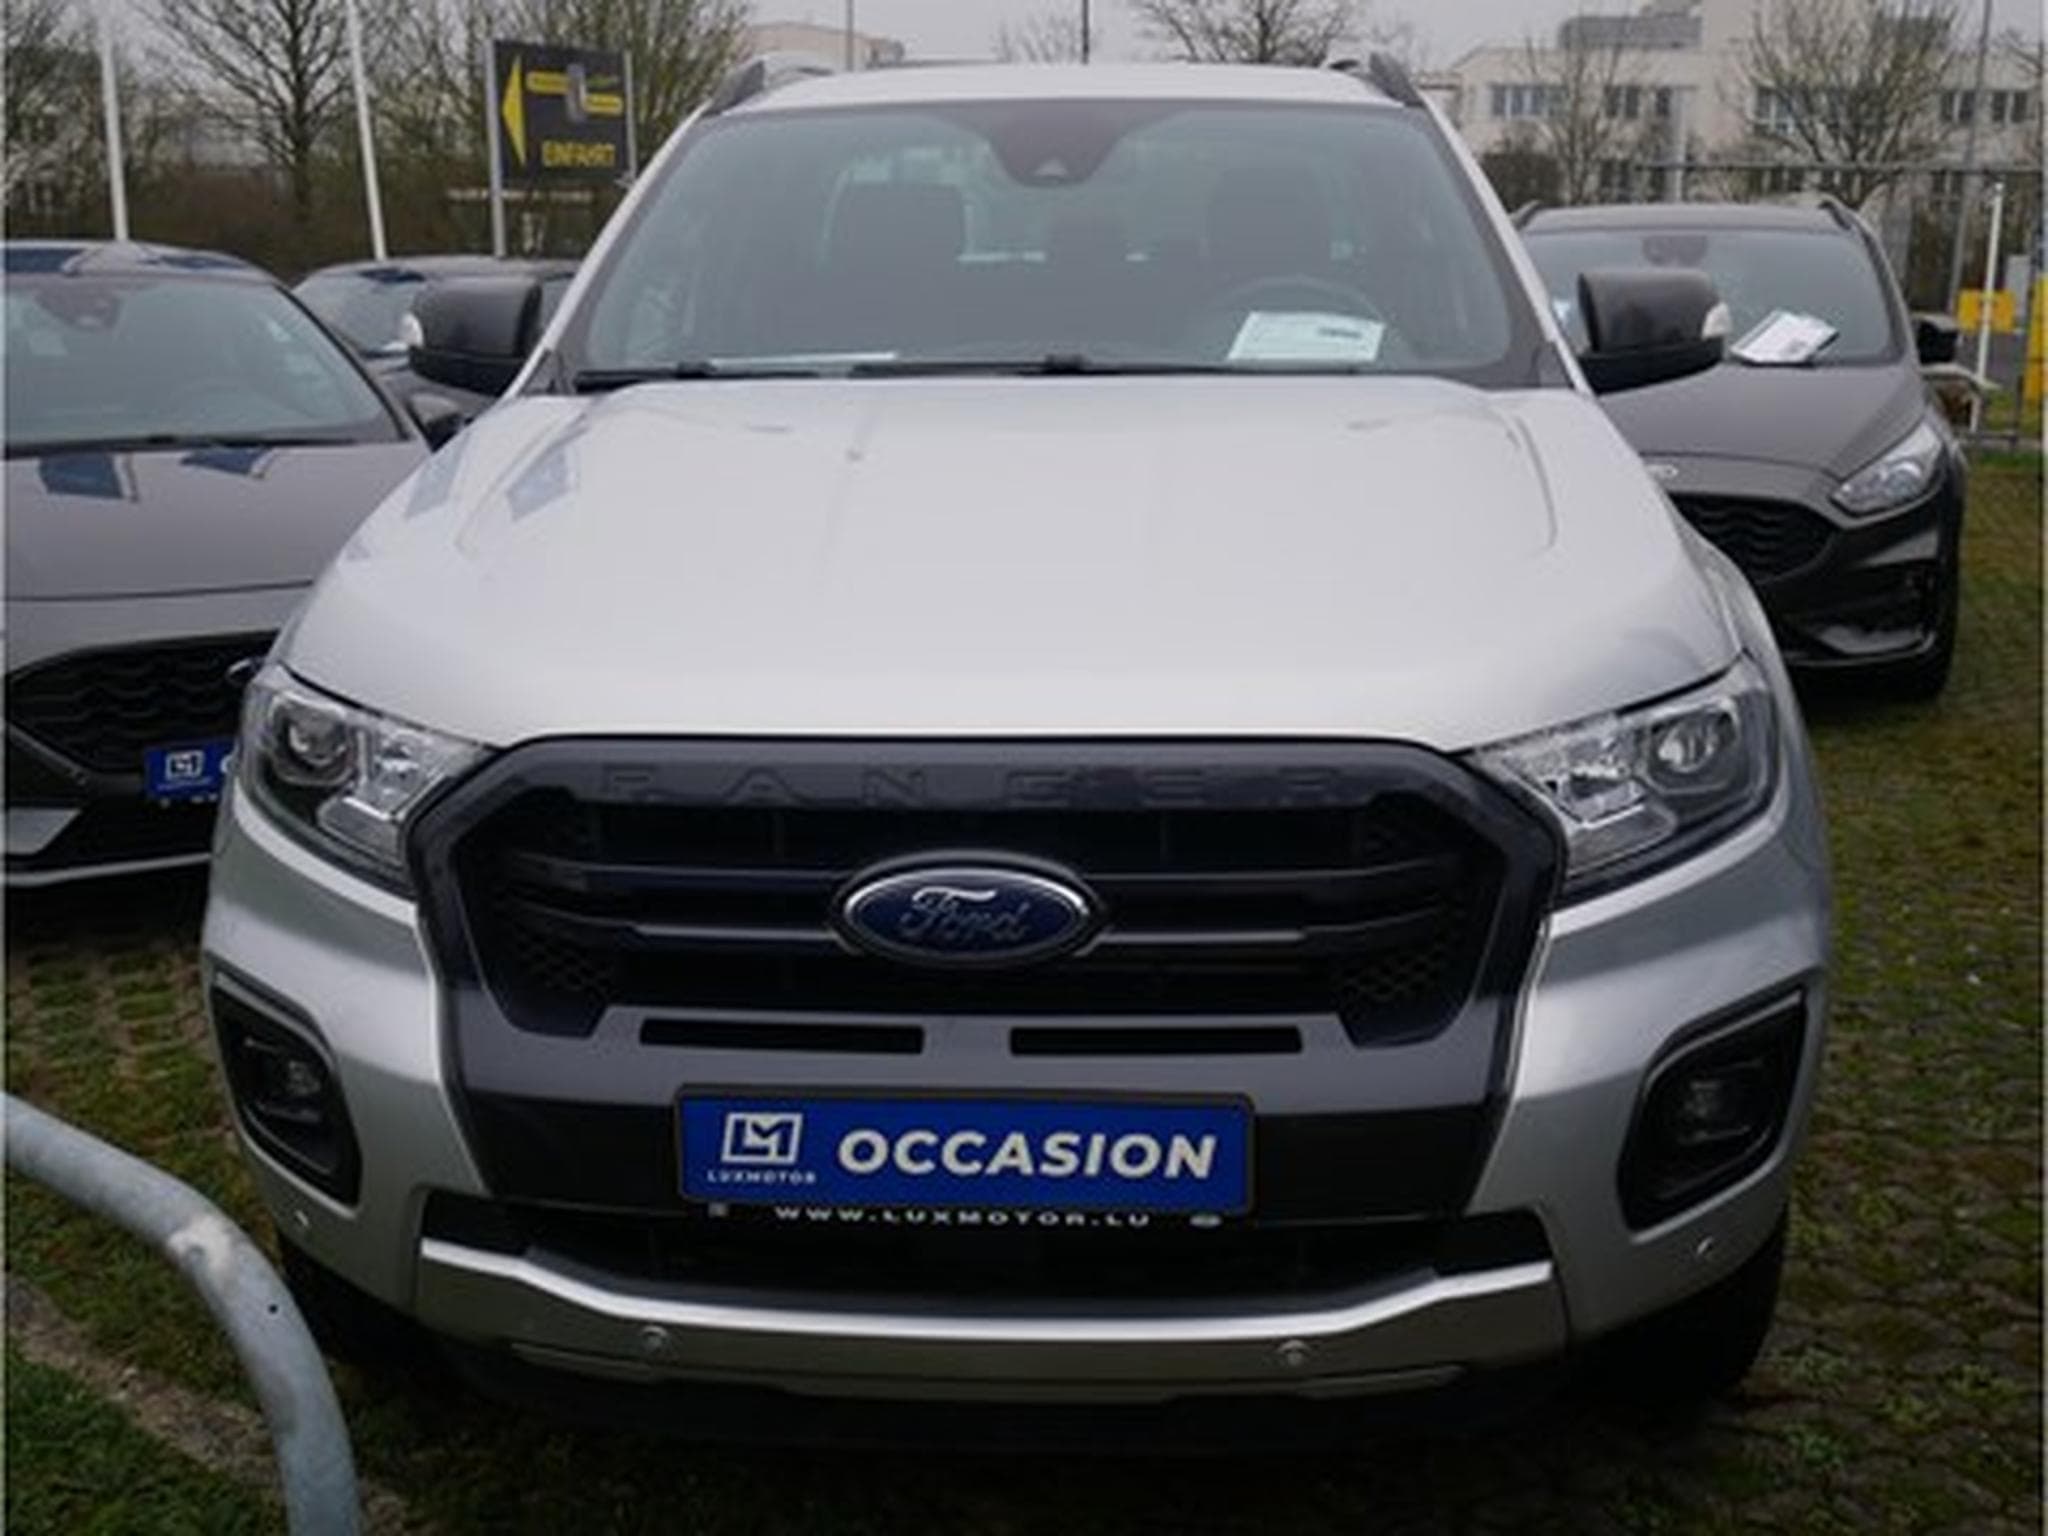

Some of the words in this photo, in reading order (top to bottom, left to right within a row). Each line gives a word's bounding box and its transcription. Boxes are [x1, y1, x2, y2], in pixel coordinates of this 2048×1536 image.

[900, 885, 1031, 942] Ford
[706, 1169, 817, 1186] LUXMOTOR
[838, 1129, 1217, 1180] OCCASION
